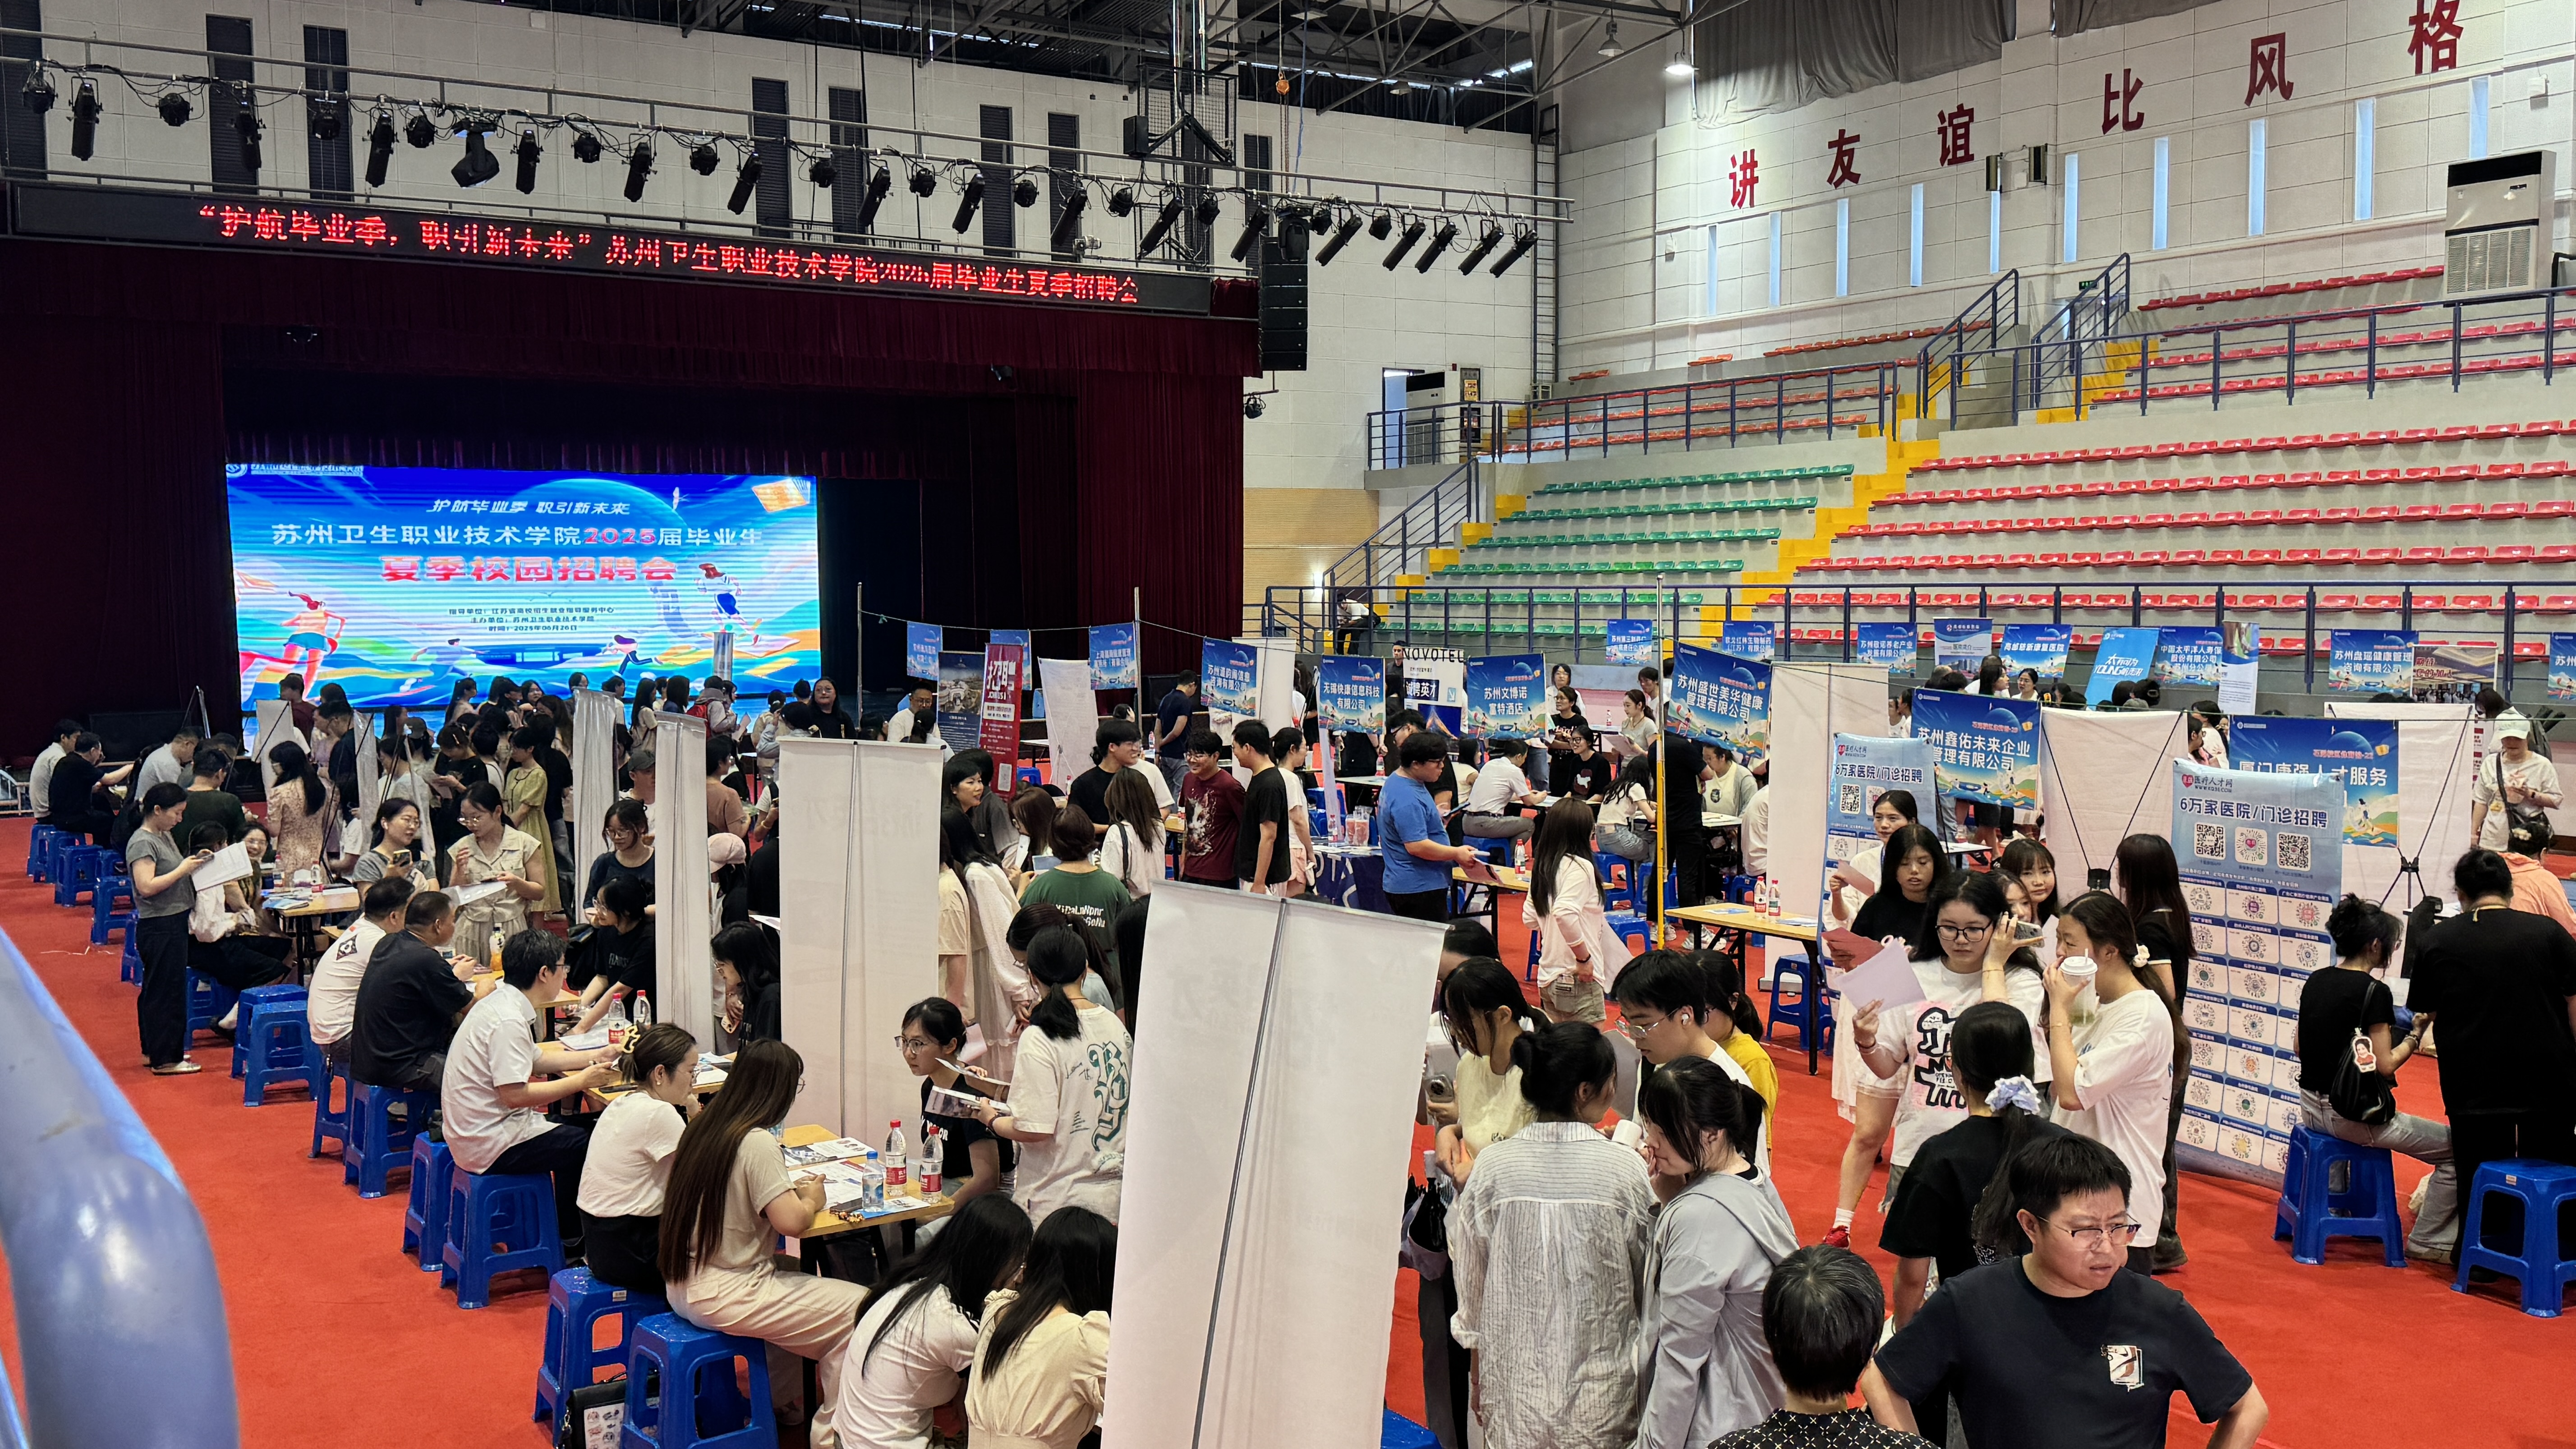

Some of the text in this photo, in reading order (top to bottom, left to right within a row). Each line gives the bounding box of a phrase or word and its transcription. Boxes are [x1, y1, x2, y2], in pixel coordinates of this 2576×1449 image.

[426, 499, 630, 515] 护航毕业季 职引新未来
[271, 524, 763, 547] 苏州卫生职业技术学院2025届毕业生
[380, 556, 677, 582] 夏季校园招聘会
[1403, 648, 1464, 663] NOVOTEL
[2344, 662, 2402, 673] 咨询有限公司
[1337, 697, 1366, 710] 有限公司
[1677, 674, 1763, 710] 苏州盛世美华健康
[1686, 691, 1750, 722] 管理有限公司
[1917, 727, 2031, 758] 苏州鑫佑未来企业
[1933, 746, 2014, 771] 管理有限公司
[1835, 764, 1923, 783] 6万家医院/门诊招聘
[2194, 775, 2233, 788] 医疗人才网
[2180, 798, 2328, 828] 6万家医院/门诊招聘
